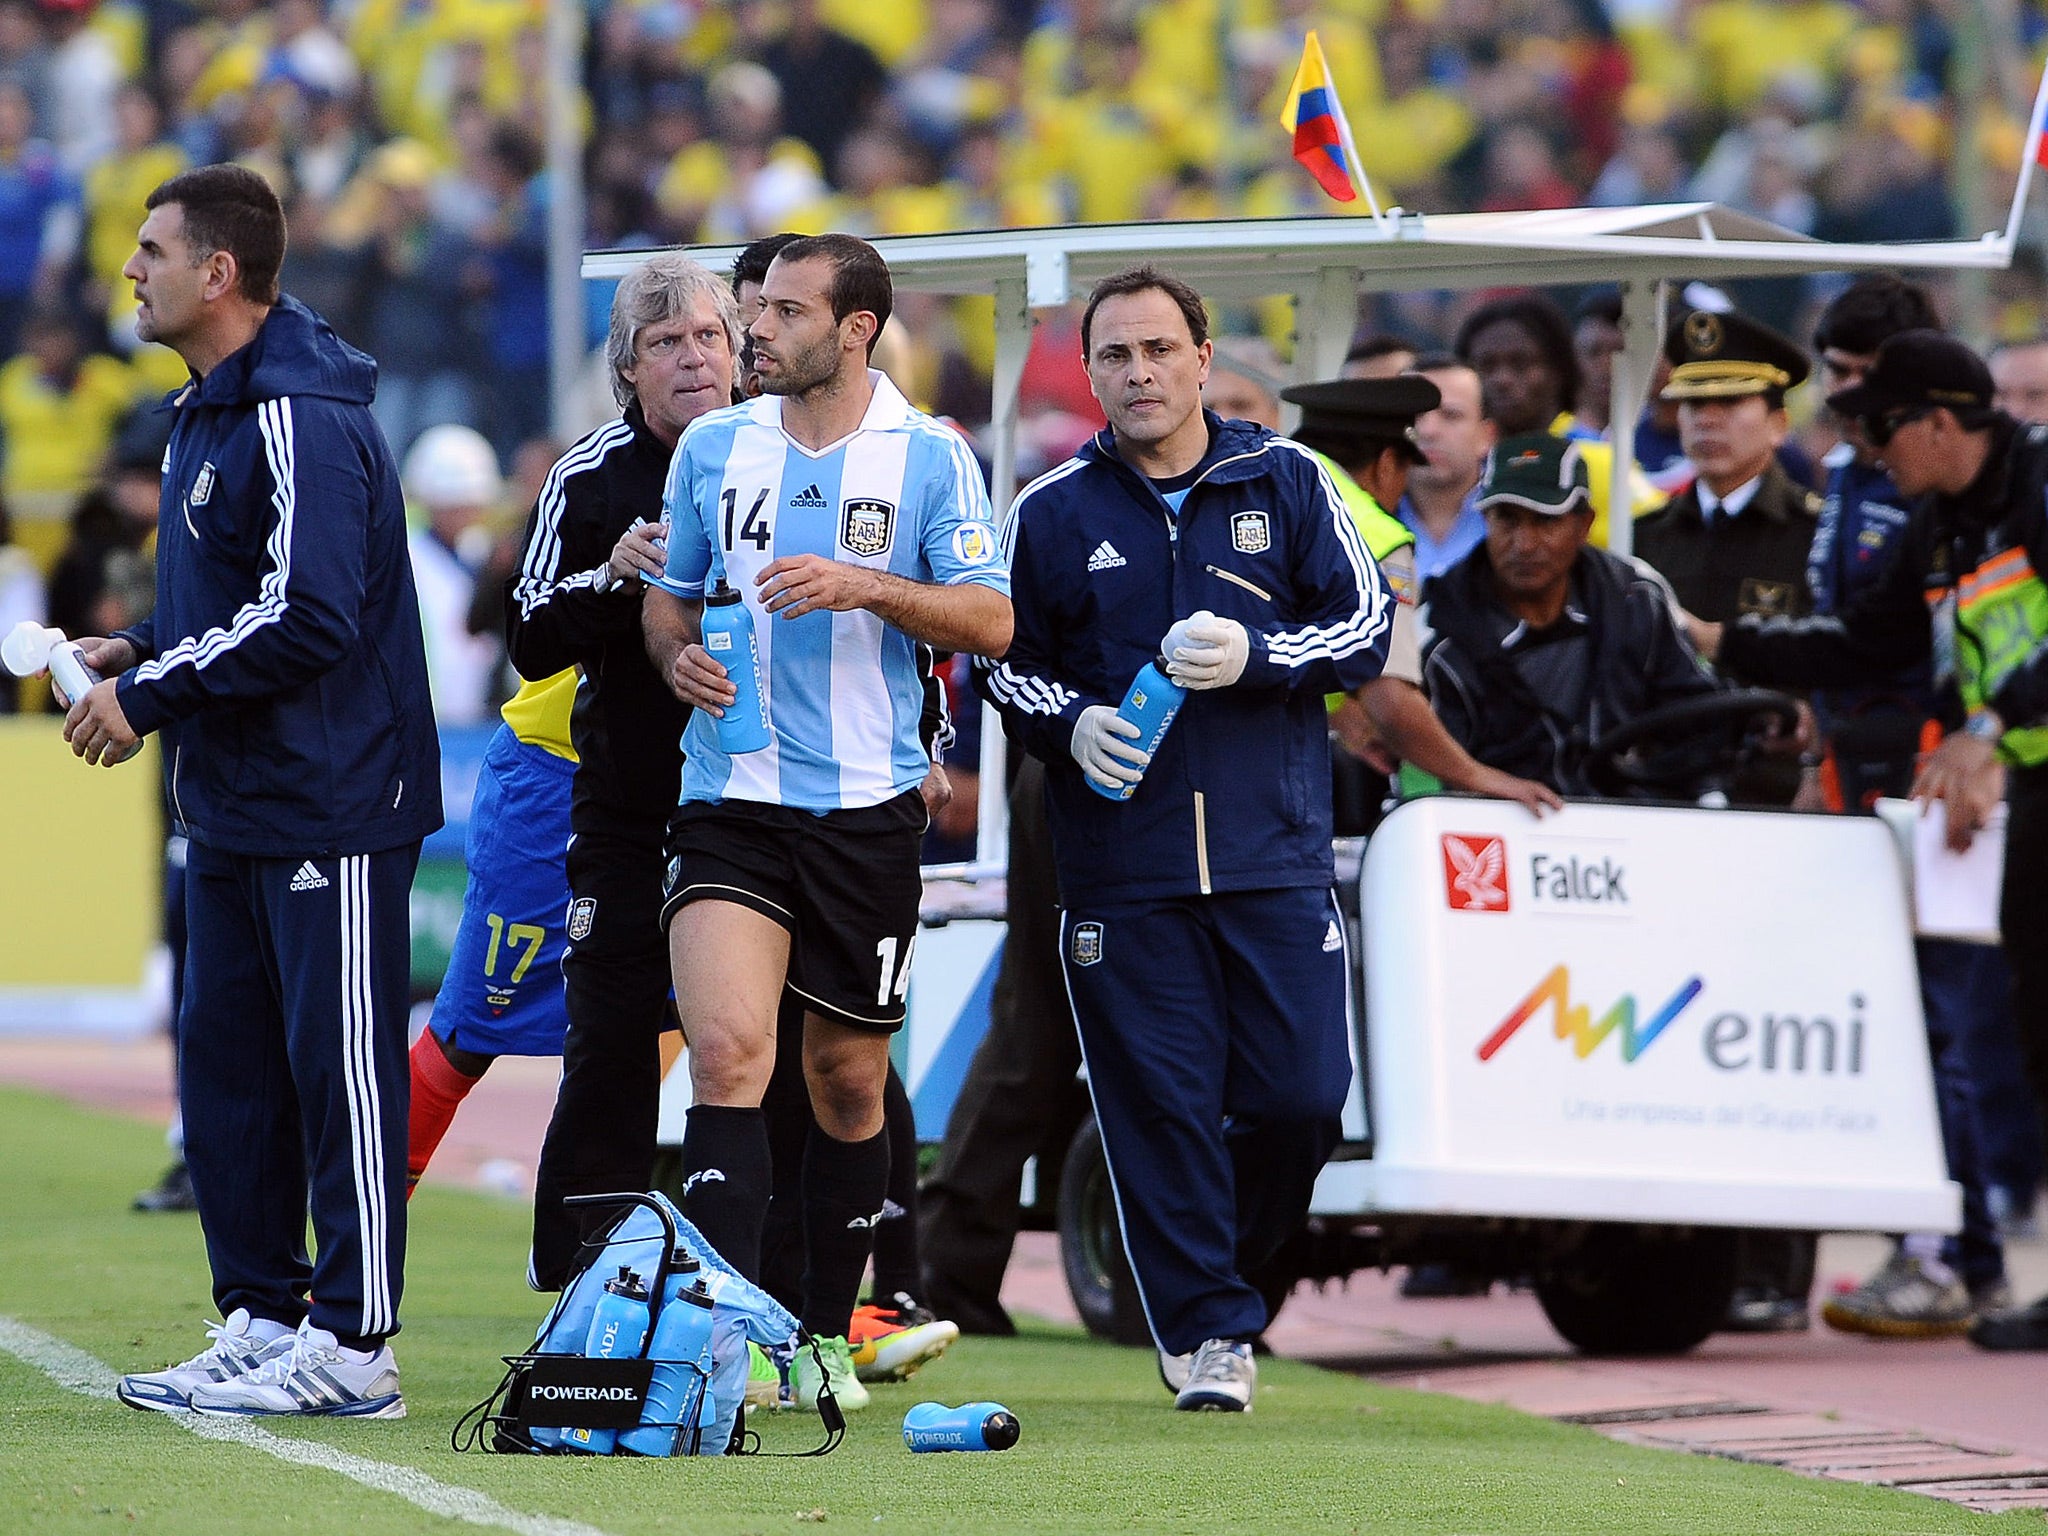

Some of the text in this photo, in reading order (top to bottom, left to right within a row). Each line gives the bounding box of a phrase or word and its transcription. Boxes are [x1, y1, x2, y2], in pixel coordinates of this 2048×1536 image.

[721, 487, 771, 552] 14
[789, 498, 827, 509] adidas
[1087, 555, 1127, 572] adidas
[289, 876, 330, 892] adidas
[1531, 854, 1629, 902] Falck
[484, 912, 545, 984] 17
[1704, 993, 1867, 1075] emi
[531, 1386, 638, 1400] POWERADE.
